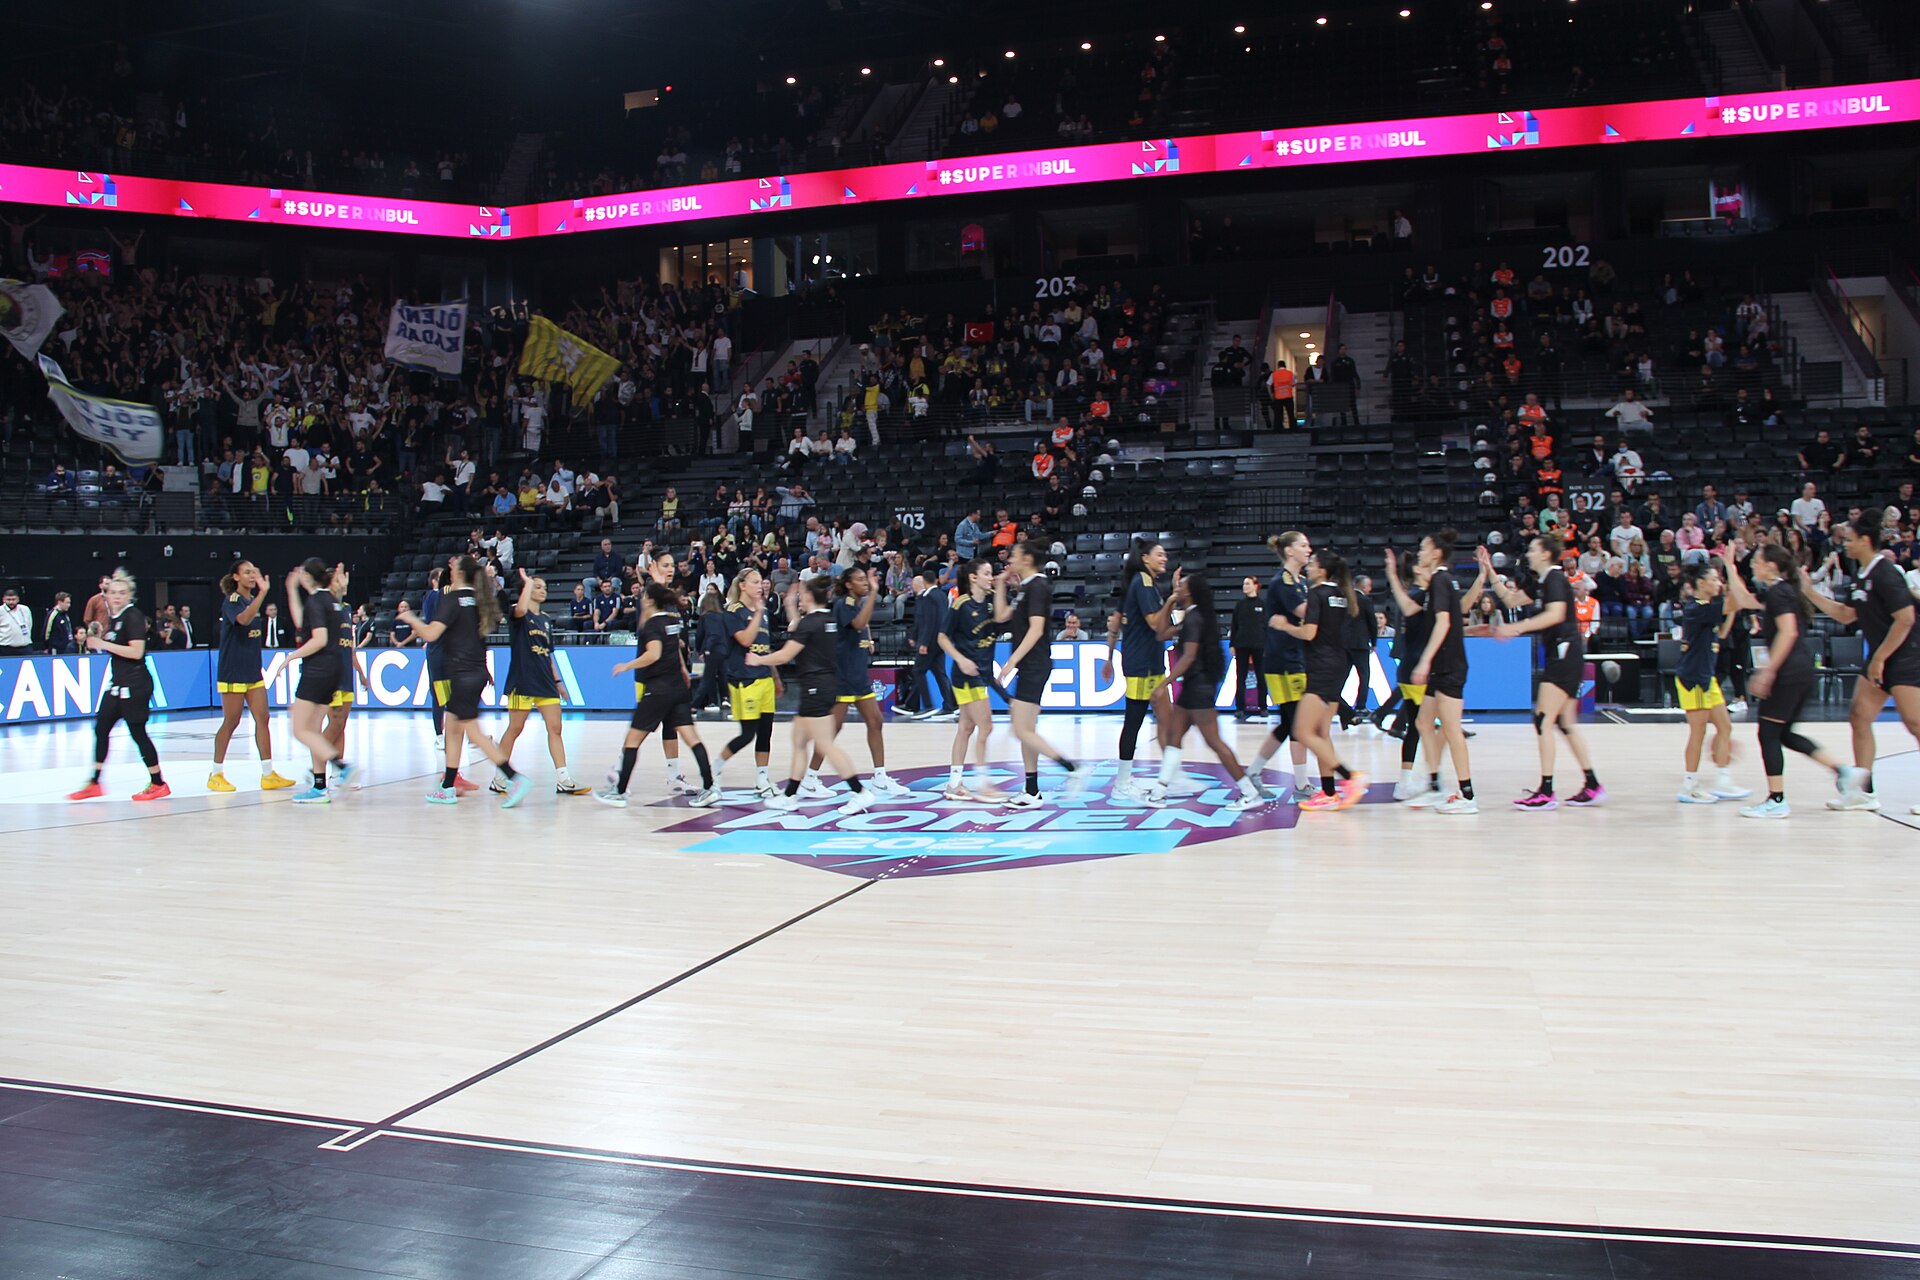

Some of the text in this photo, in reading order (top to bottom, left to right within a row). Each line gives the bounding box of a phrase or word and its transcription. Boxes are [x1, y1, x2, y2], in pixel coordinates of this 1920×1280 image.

[1543, 245, 1590, 268] 202
[1035, 276, 1076, 298] 203
[713, 808, 1244, 830] WOMEN
[807, 836, 1053, 850] 2024
